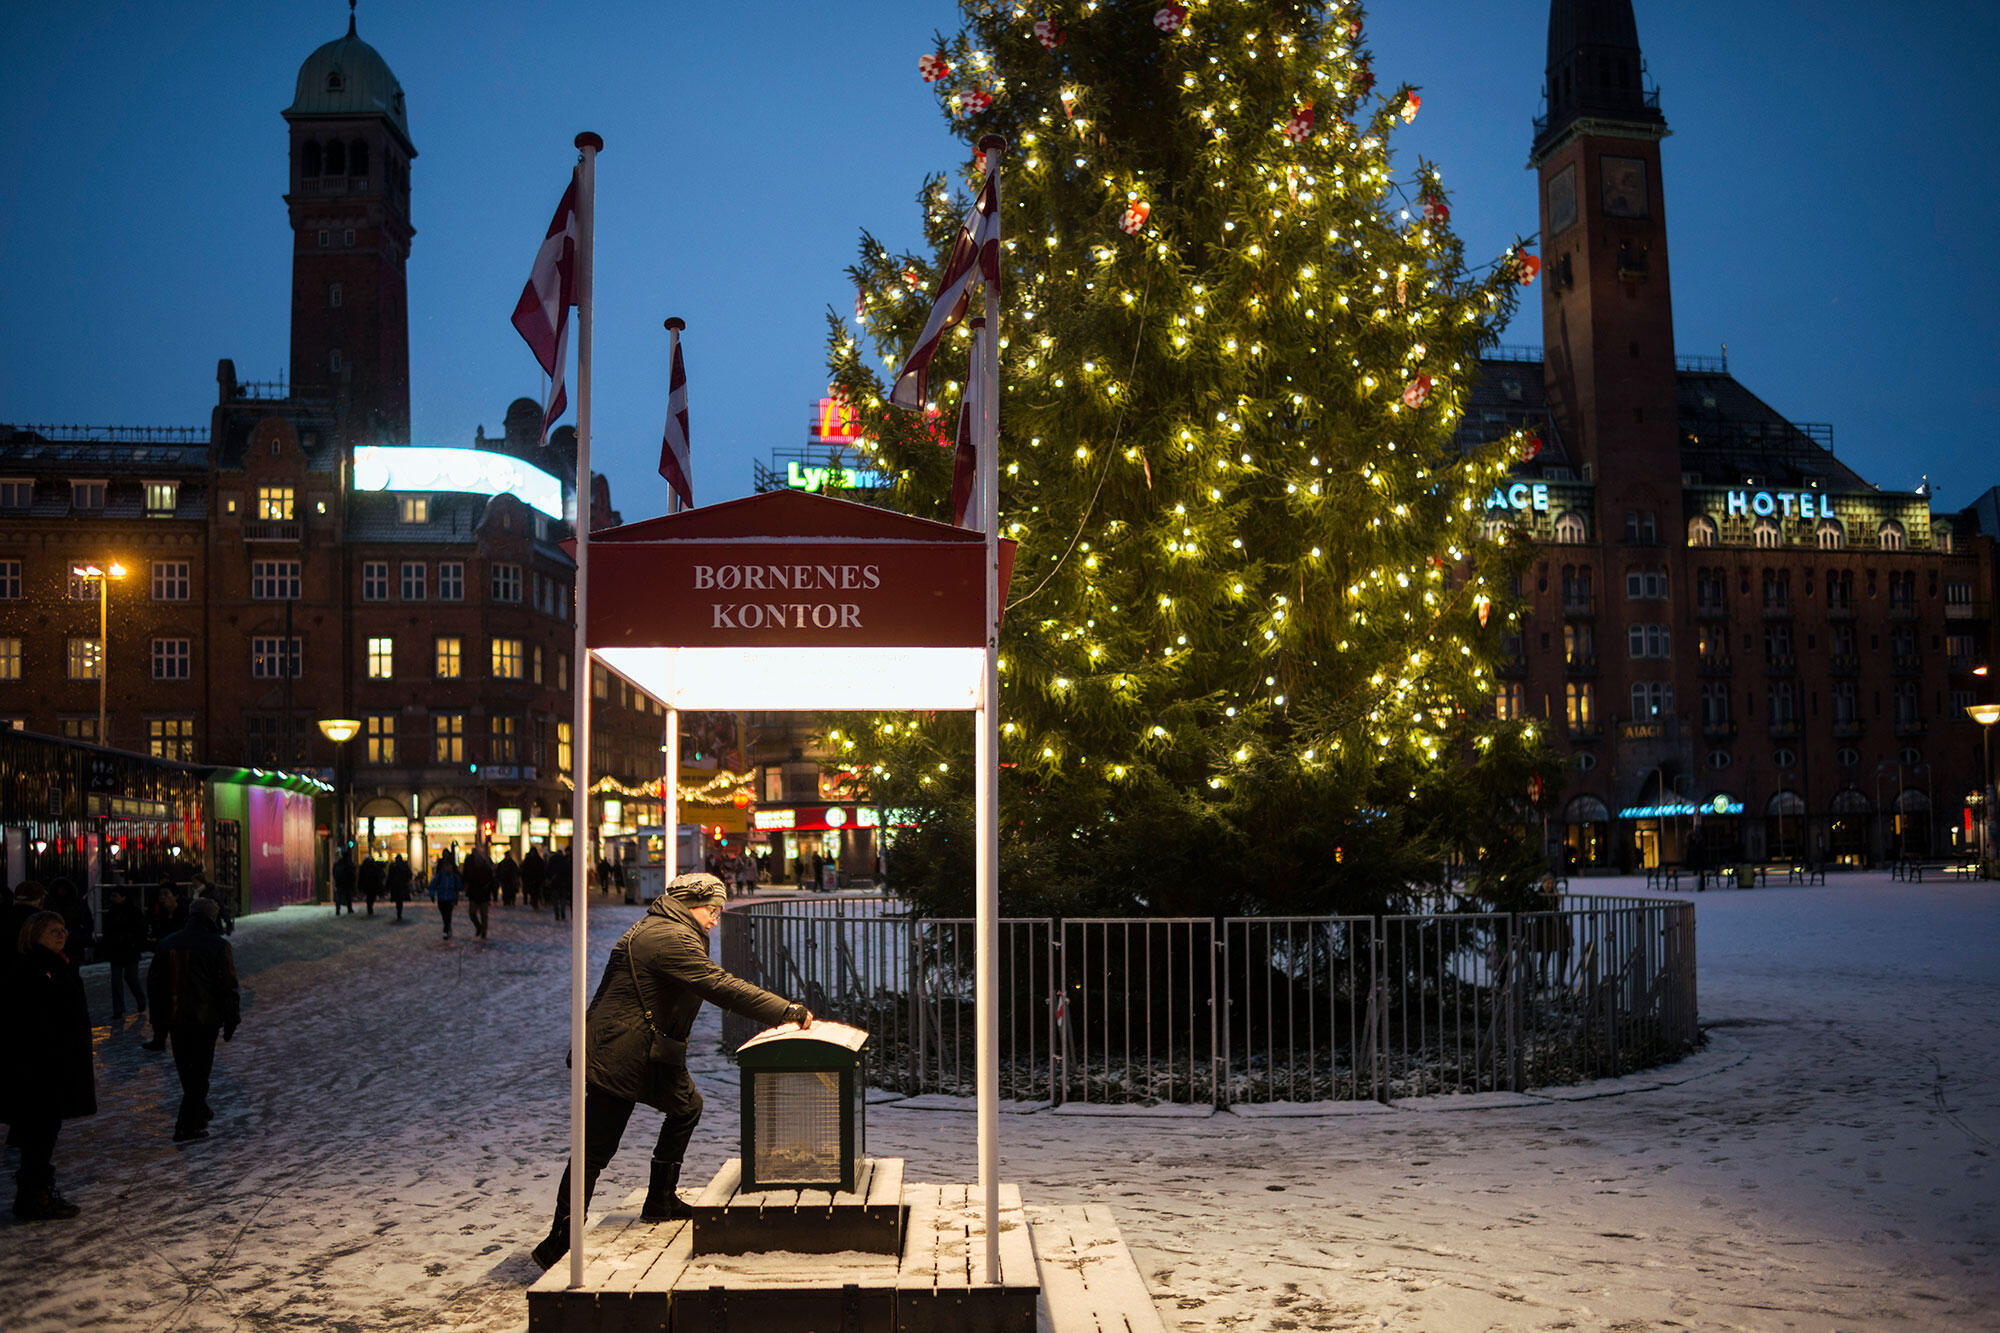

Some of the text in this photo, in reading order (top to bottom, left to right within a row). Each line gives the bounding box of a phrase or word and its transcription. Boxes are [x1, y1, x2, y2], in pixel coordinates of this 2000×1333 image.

[1727, 490, 1835, 519] HOTEL
[693, 564, 881, 590] BØRNENES
[711, 603, 863, 629] KONTOR
